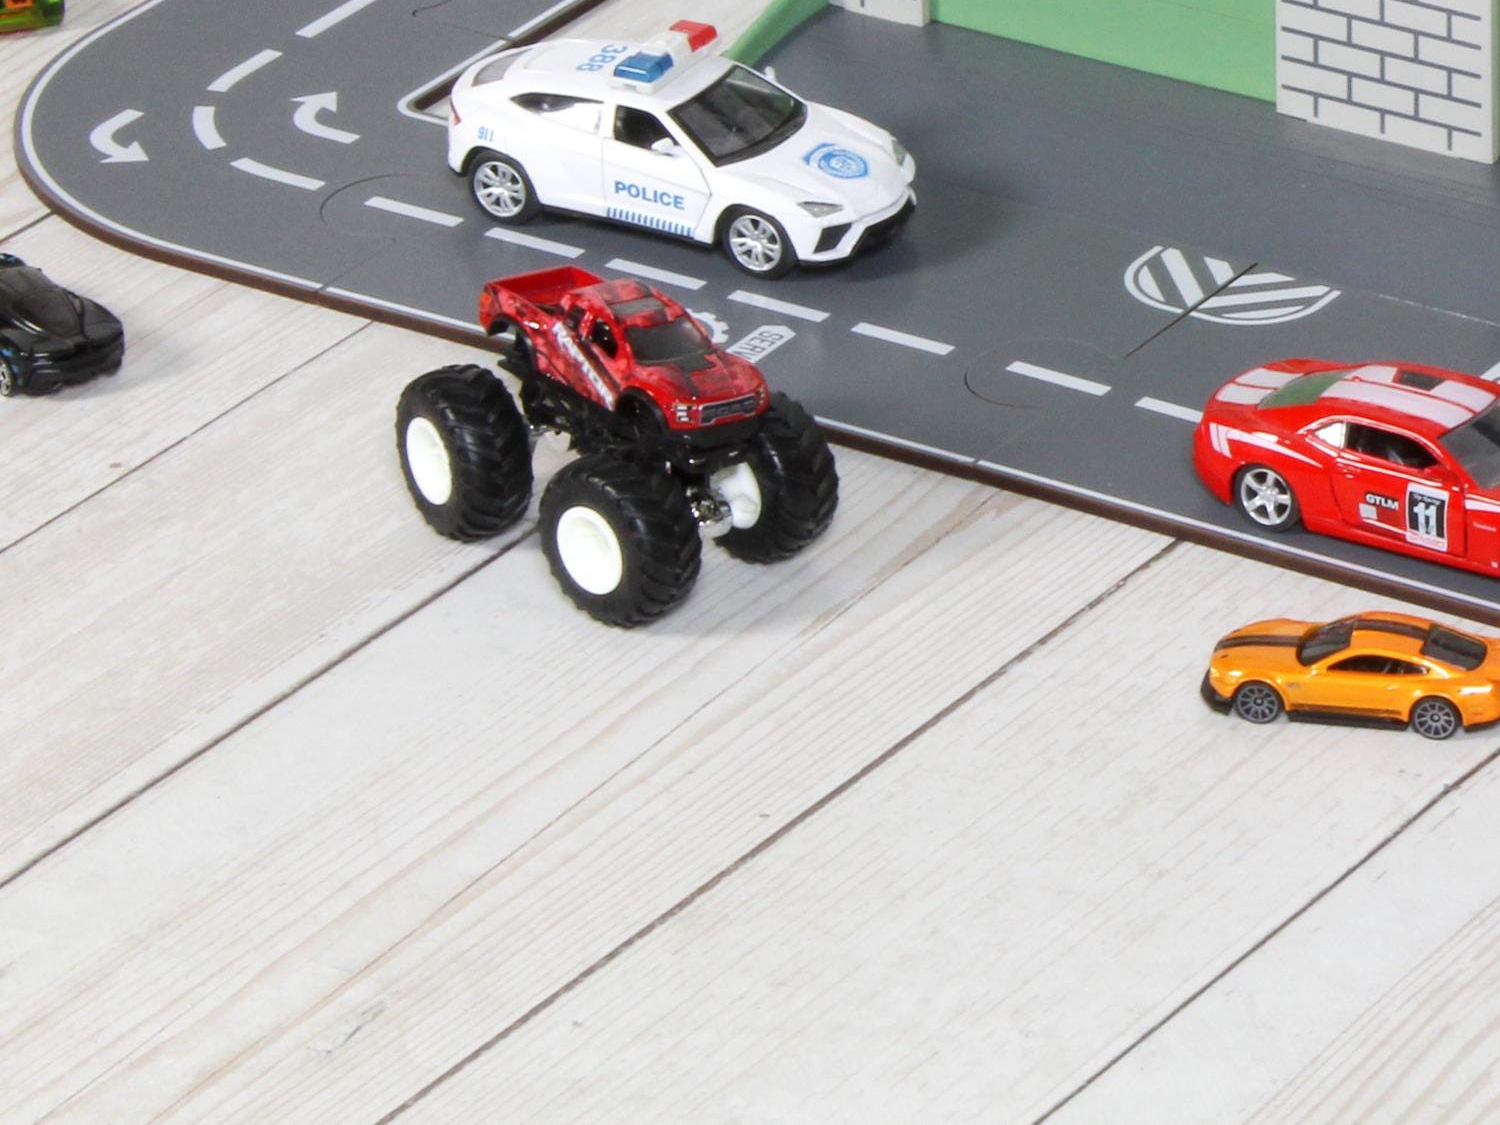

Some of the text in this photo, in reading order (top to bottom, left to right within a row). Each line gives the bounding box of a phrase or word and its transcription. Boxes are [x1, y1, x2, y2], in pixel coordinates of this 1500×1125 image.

[575, 43, 628, 72] 388
[614, 180, 686, 210] POLICE
[732, 330, 785, 360] SERV
[1366, 493, 1399, 511] GTLM
[1413, 501, 1438, 538] 11
